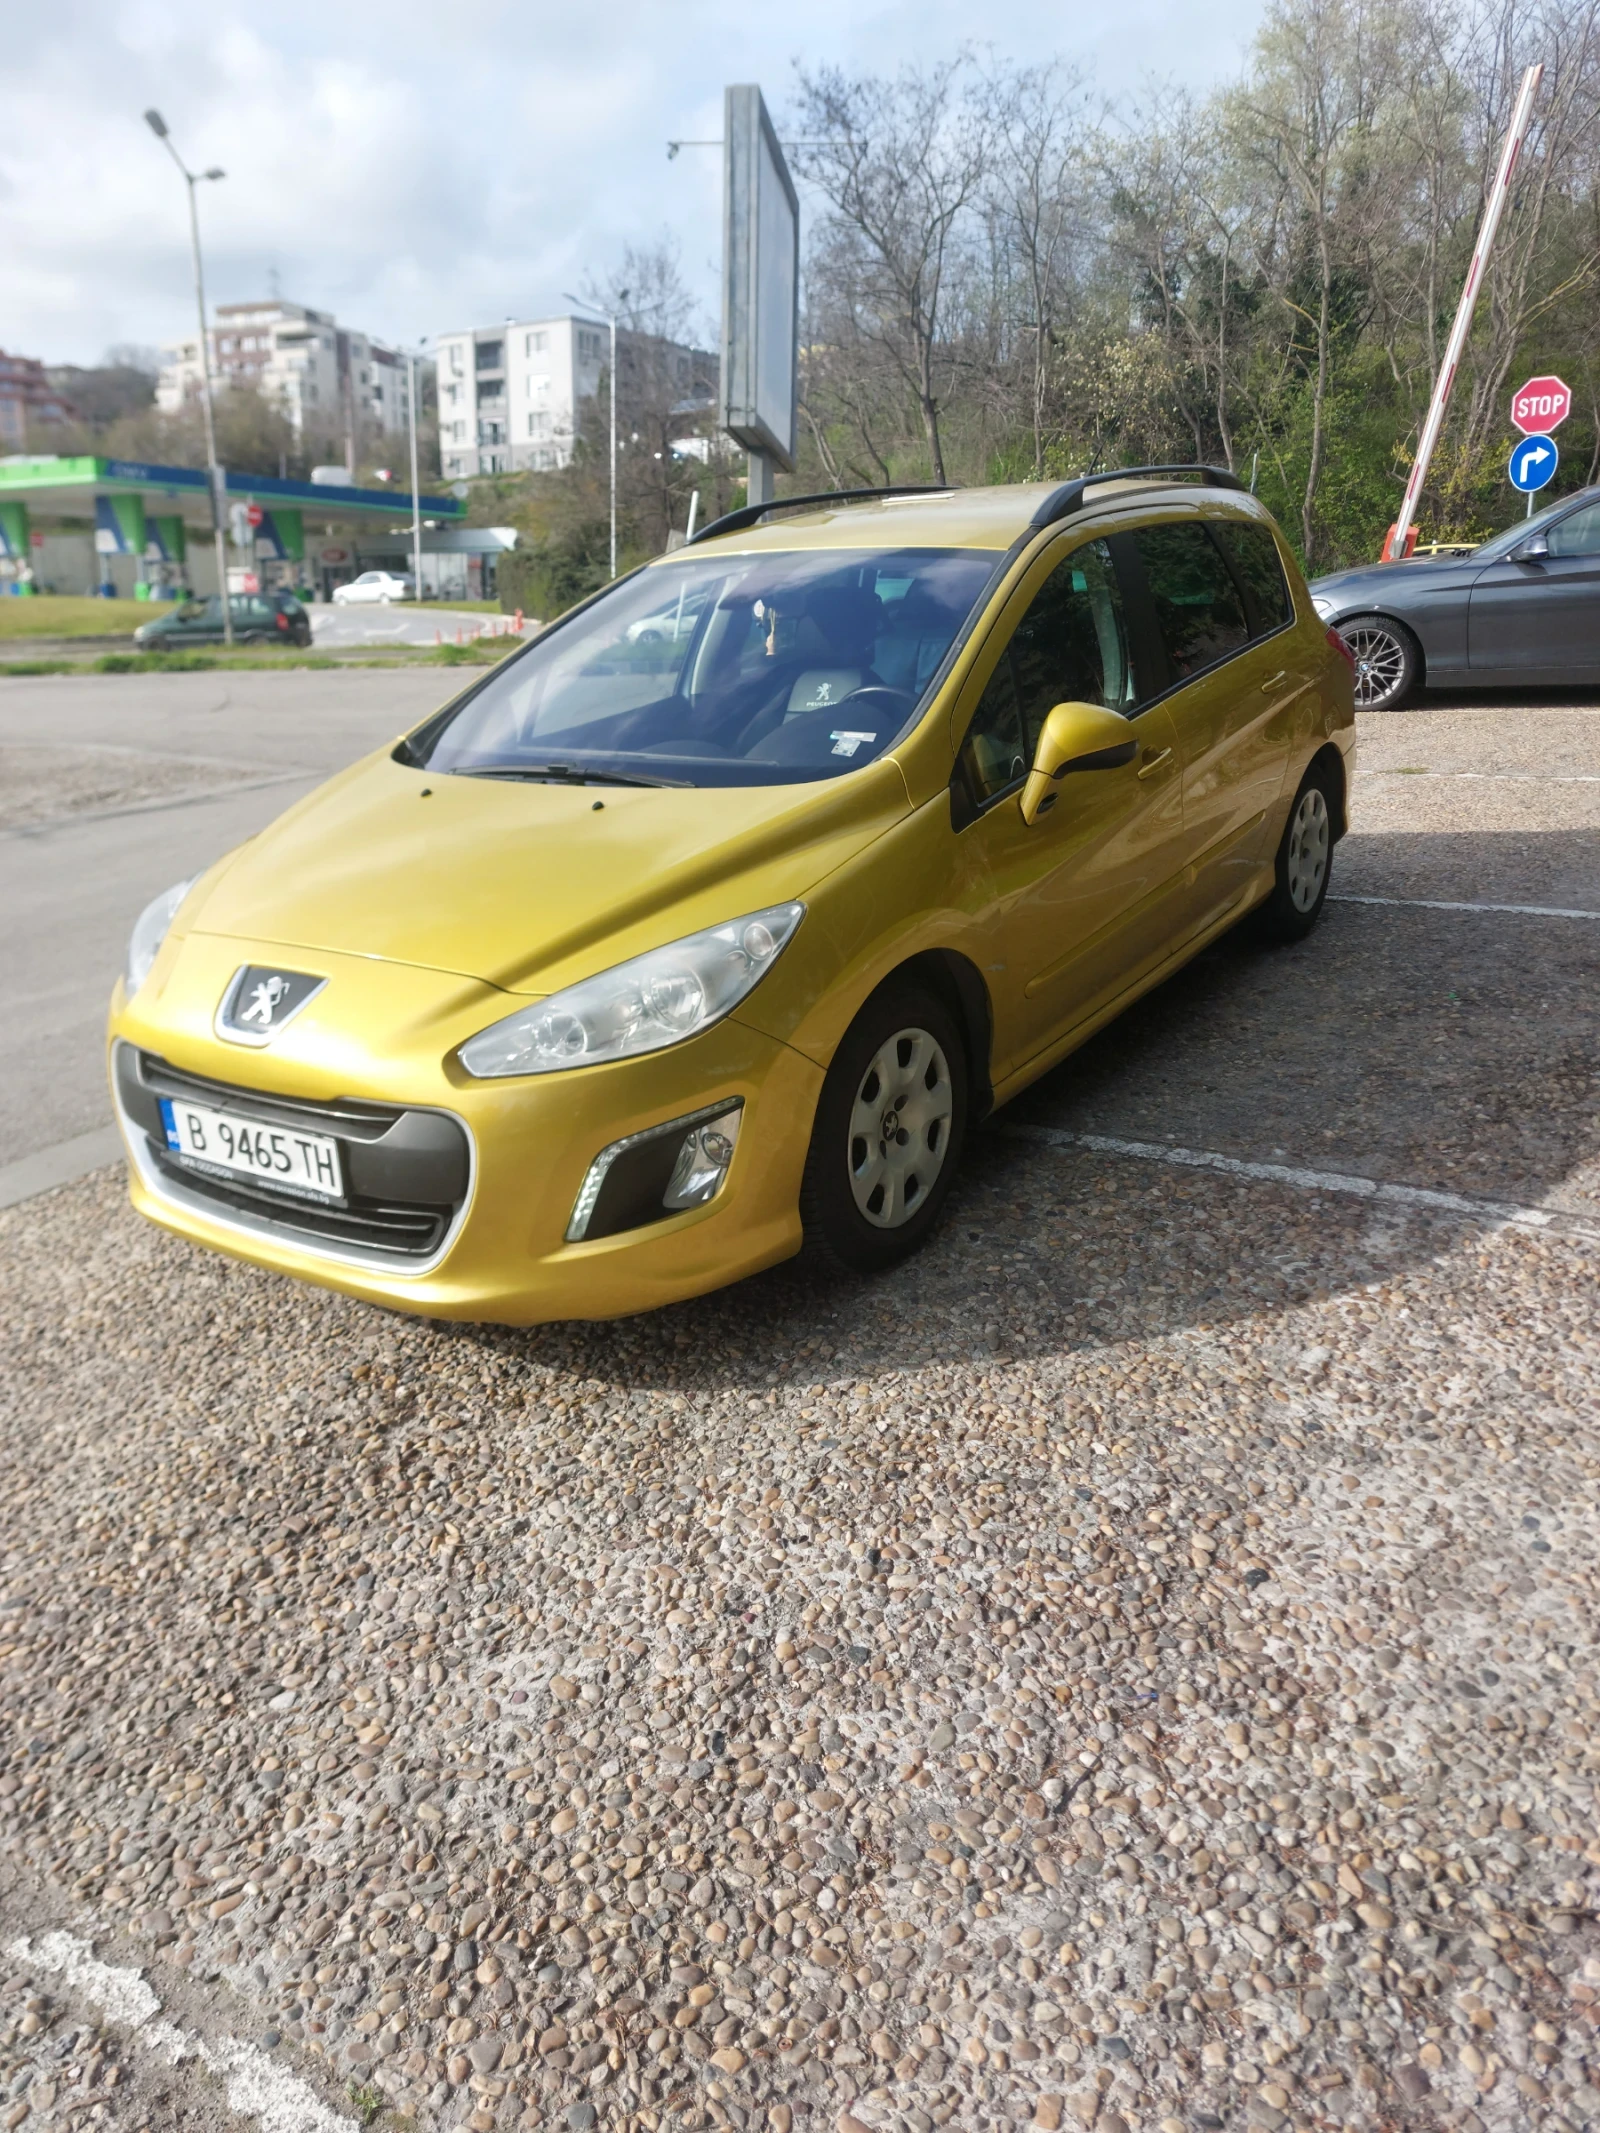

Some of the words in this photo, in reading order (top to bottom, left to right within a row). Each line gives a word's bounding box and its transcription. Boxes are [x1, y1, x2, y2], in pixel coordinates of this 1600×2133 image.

[1517, 394, 1565, 418] STOP
[187, 1114, 206, 1151] B
[219, 1123, 292, 1173] 9465
[294, 1139, 336, 1187] TH
